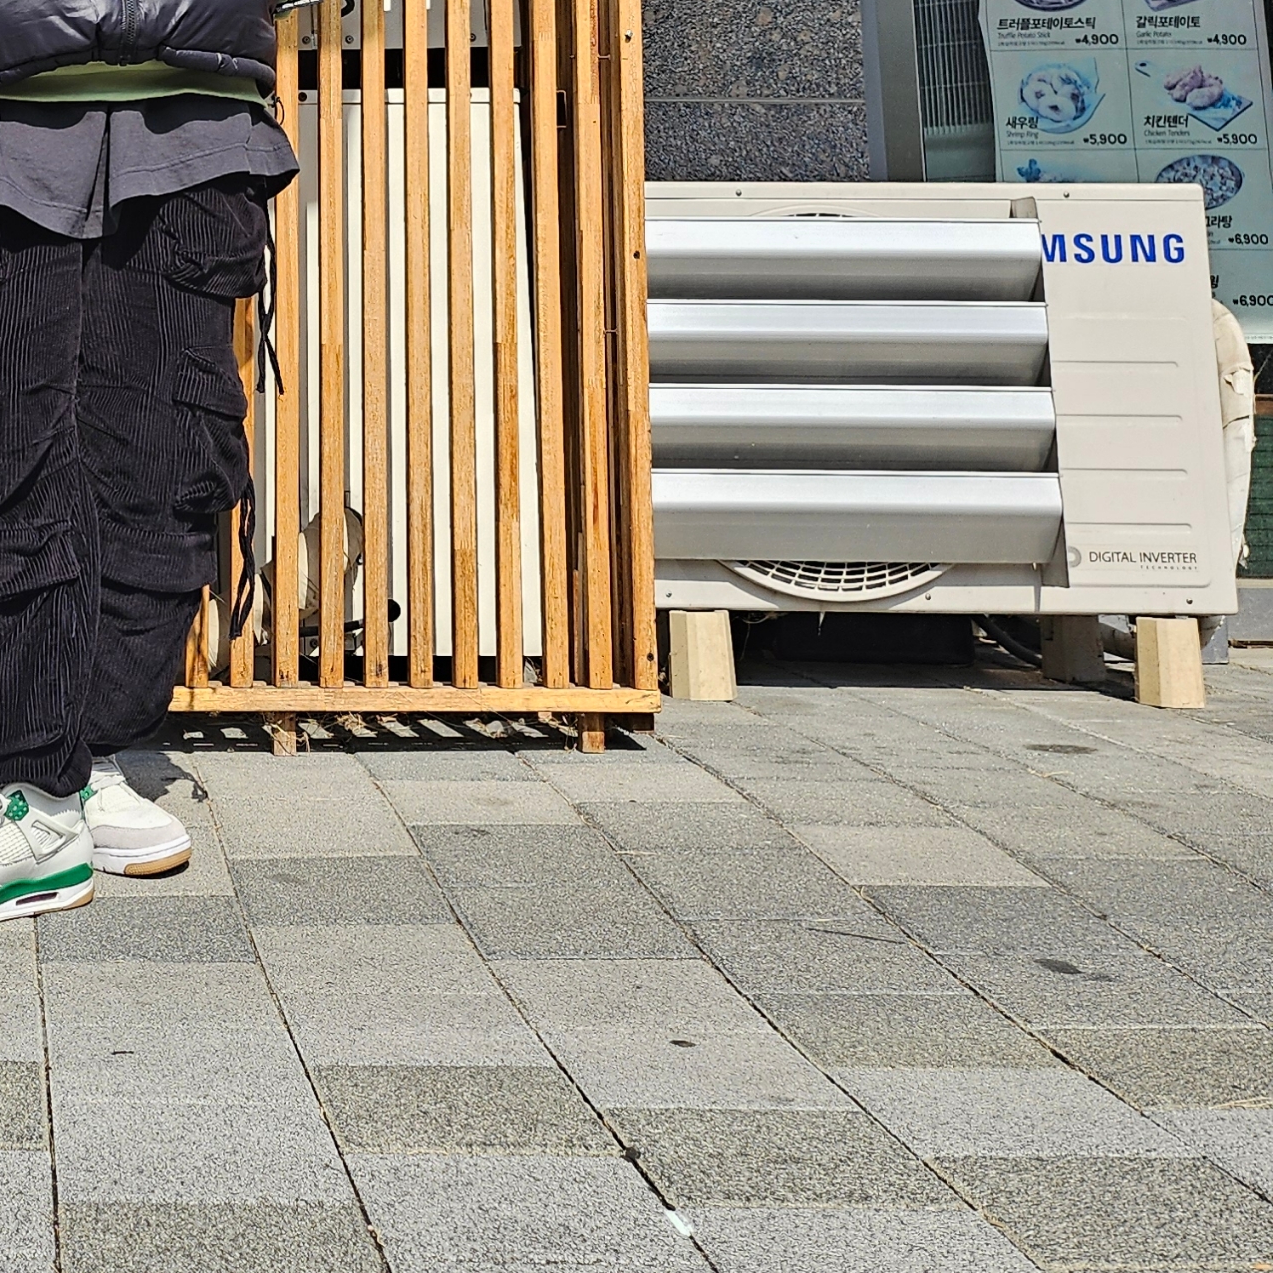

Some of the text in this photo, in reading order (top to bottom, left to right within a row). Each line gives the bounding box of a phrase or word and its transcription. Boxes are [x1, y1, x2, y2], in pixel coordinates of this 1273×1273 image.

[997, 16, 1096, 31] 트러플포테이토스틱
[1135, 15, 1201, 28] 갈릭포테이토
[1005, 116, 1039, 129] 새우링
[1143, 114, 1189, 128] 치킨텐더
[1006, 131, 1039, 139] Shrimp Ring
[1144, 129, 1190, 137] Chicken Tenders
[1089, 551, 1197, 564] DIGITAL INVERTER
